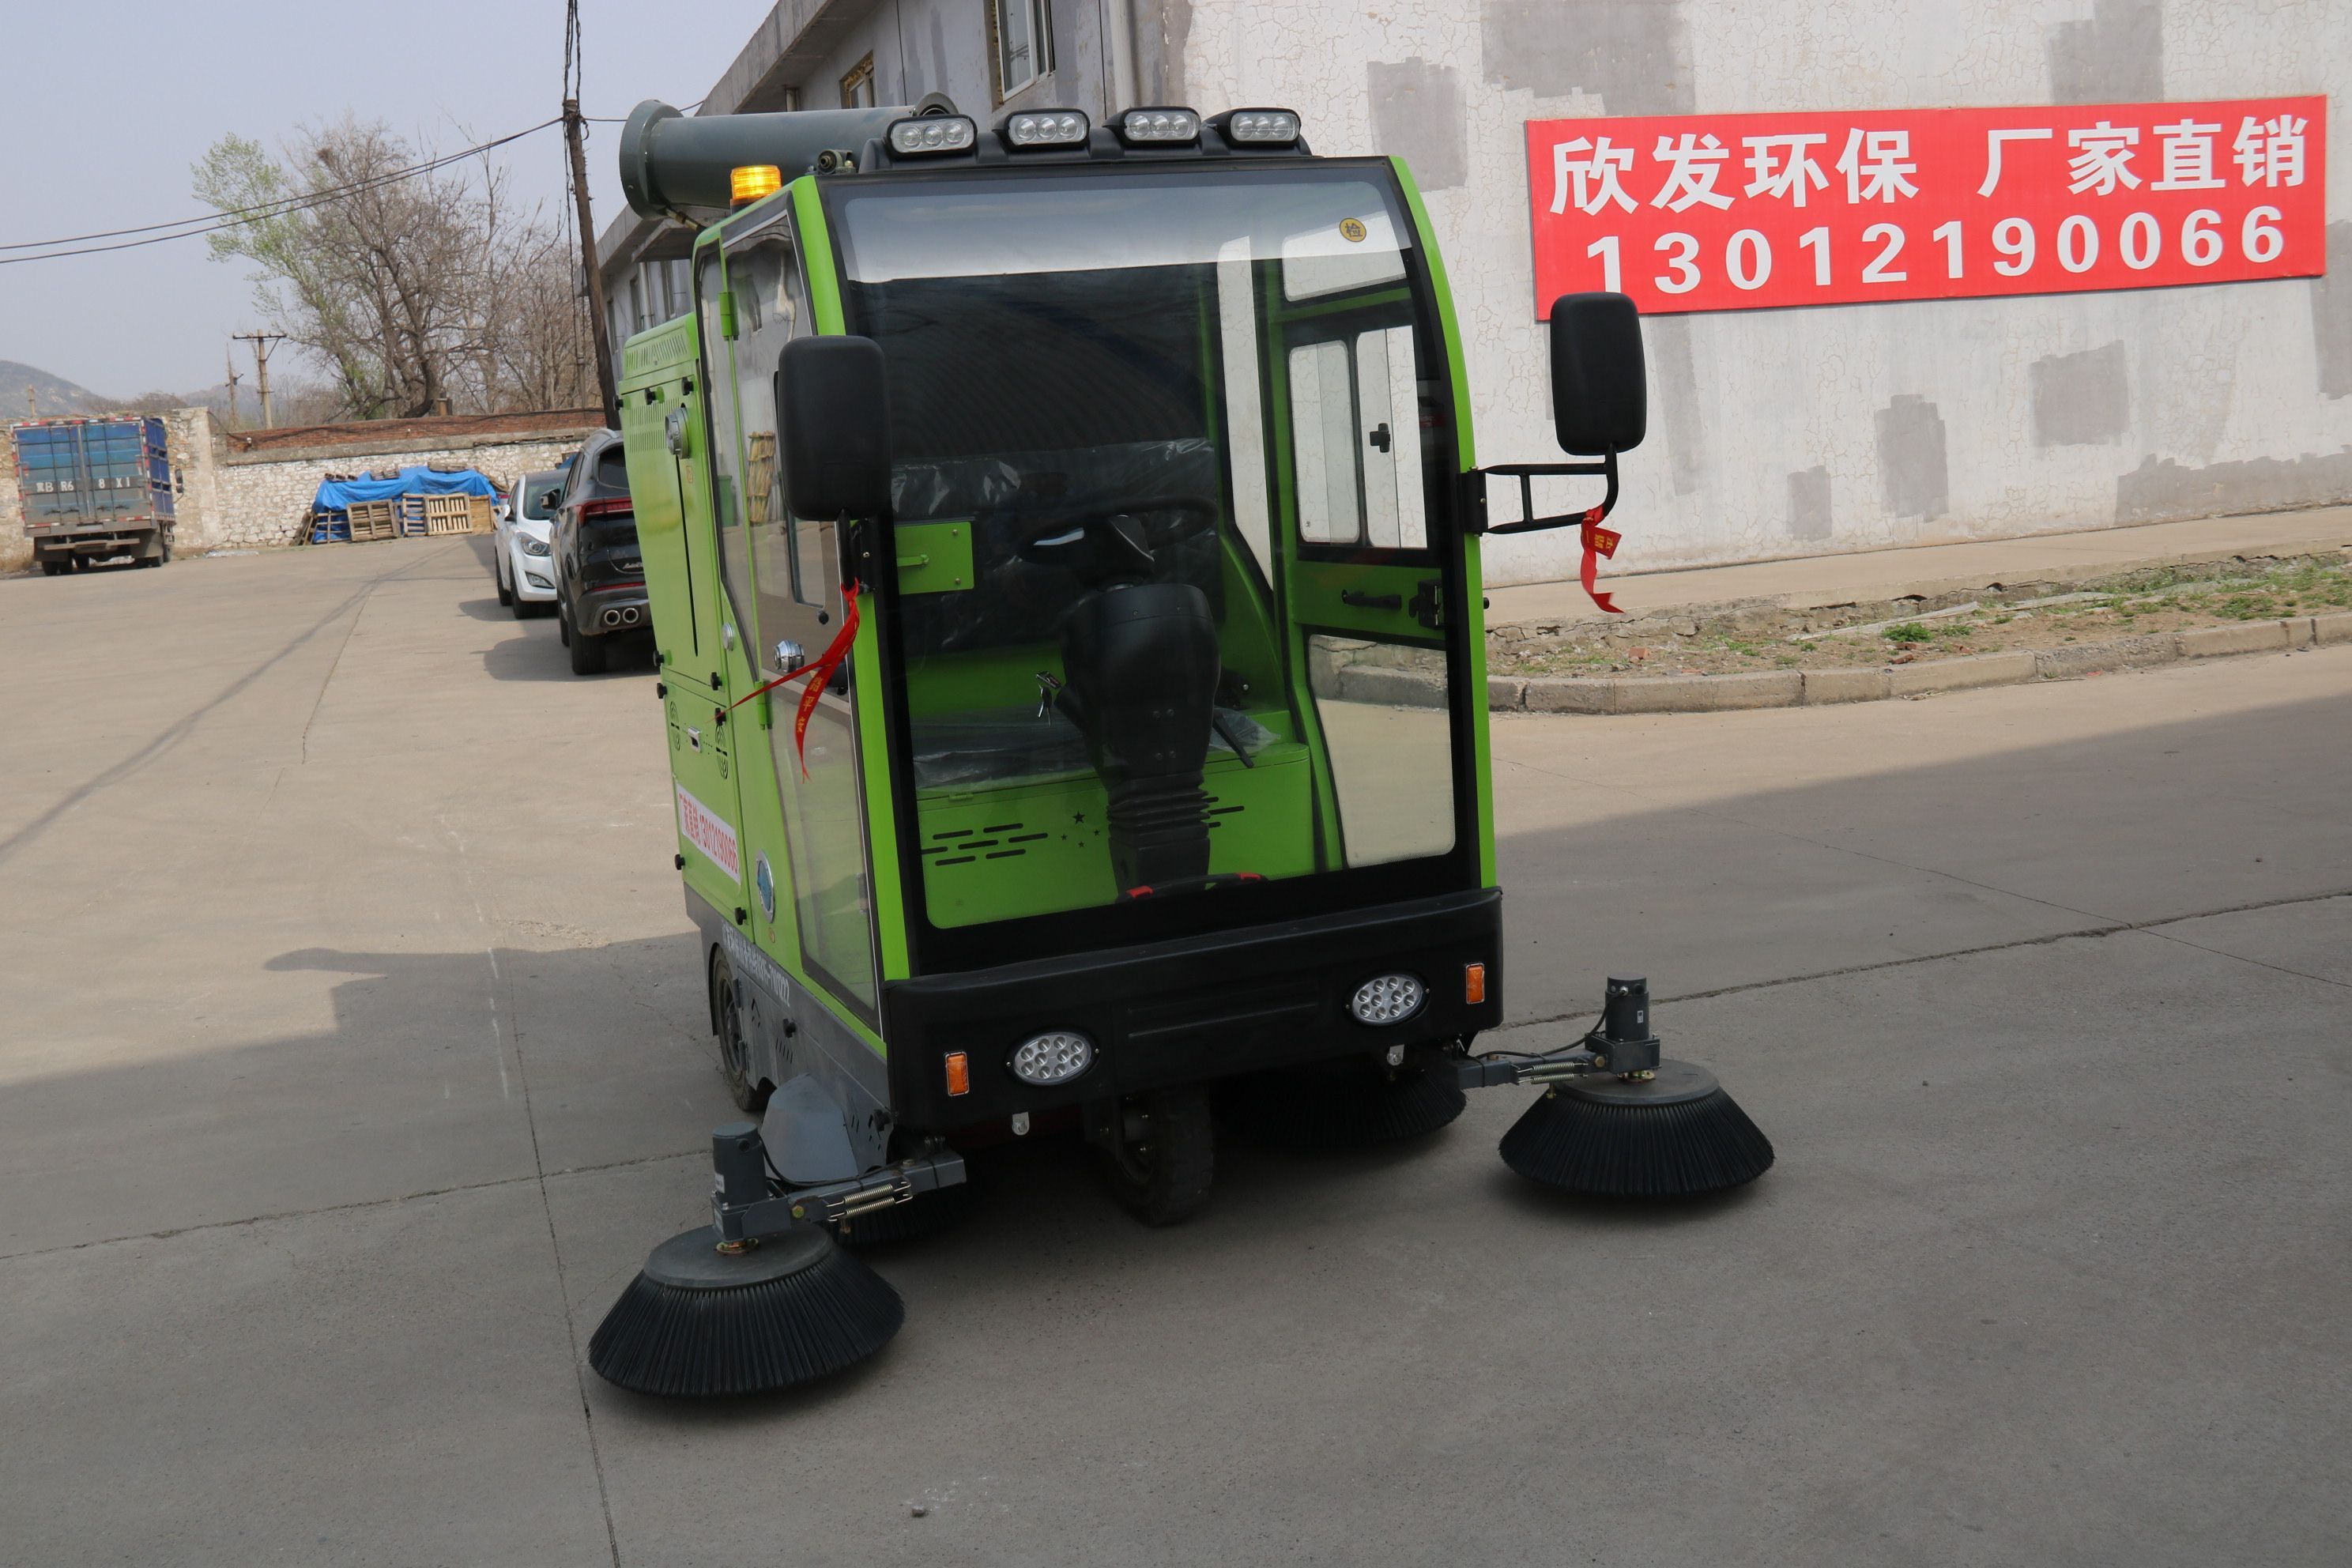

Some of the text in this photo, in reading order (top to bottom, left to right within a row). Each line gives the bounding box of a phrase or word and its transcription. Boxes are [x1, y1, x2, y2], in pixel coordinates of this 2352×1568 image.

[1549, 115, 2309, 217] 欣发环保 厂家直销
[1587, 206, 2283, 293] 13012190066
